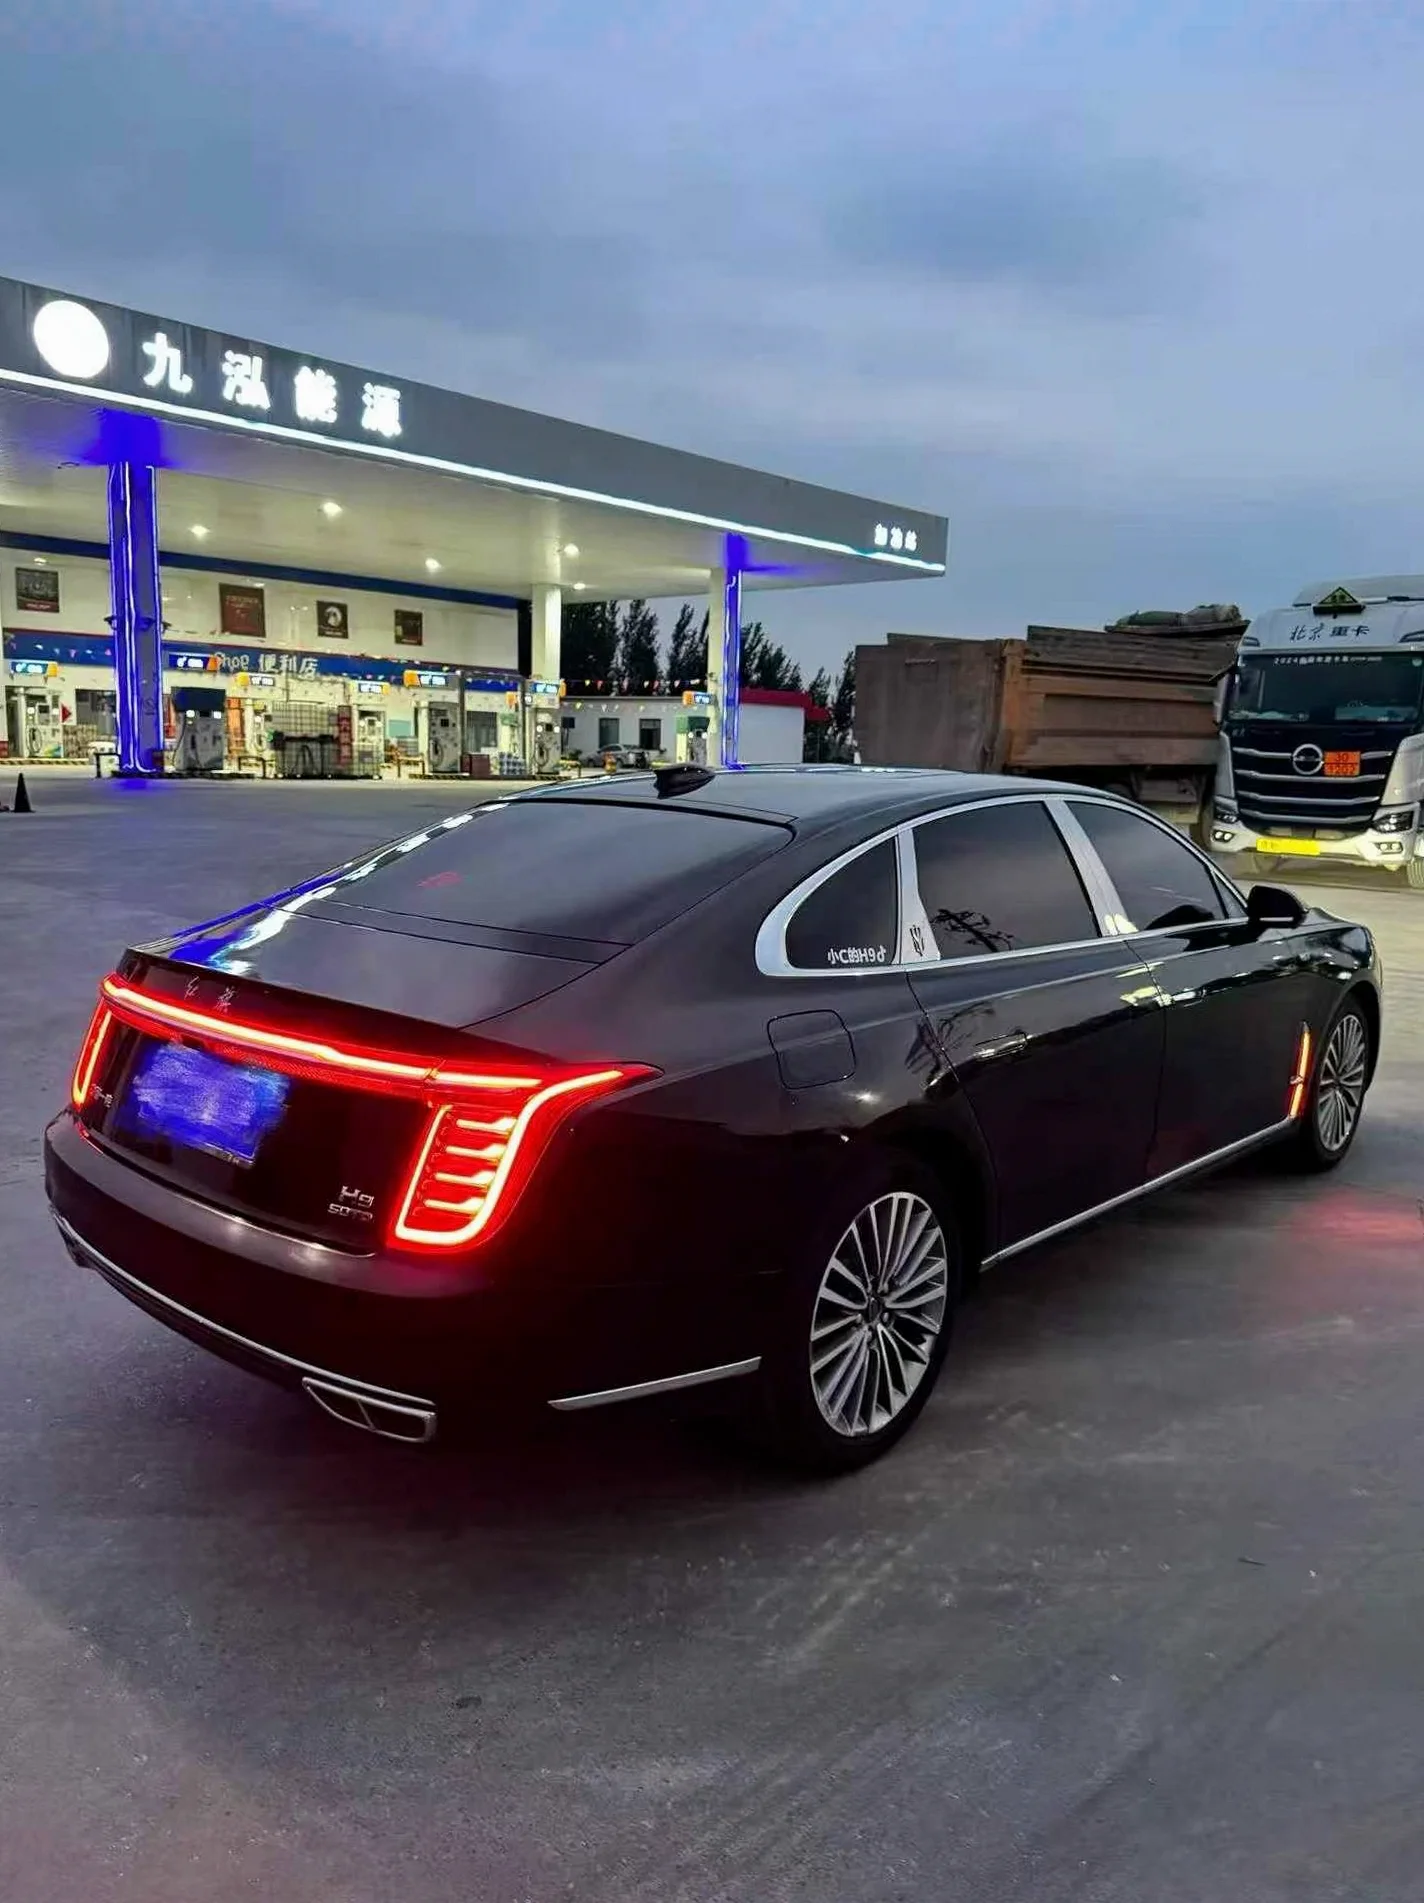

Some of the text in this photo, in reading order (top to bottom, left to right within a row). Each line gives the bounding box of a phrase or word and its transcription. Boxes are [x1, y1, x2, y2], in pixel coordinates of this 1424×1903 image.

[258, 653, 318, 679] 便利店
[338, 1185, 375, 1209] H9
